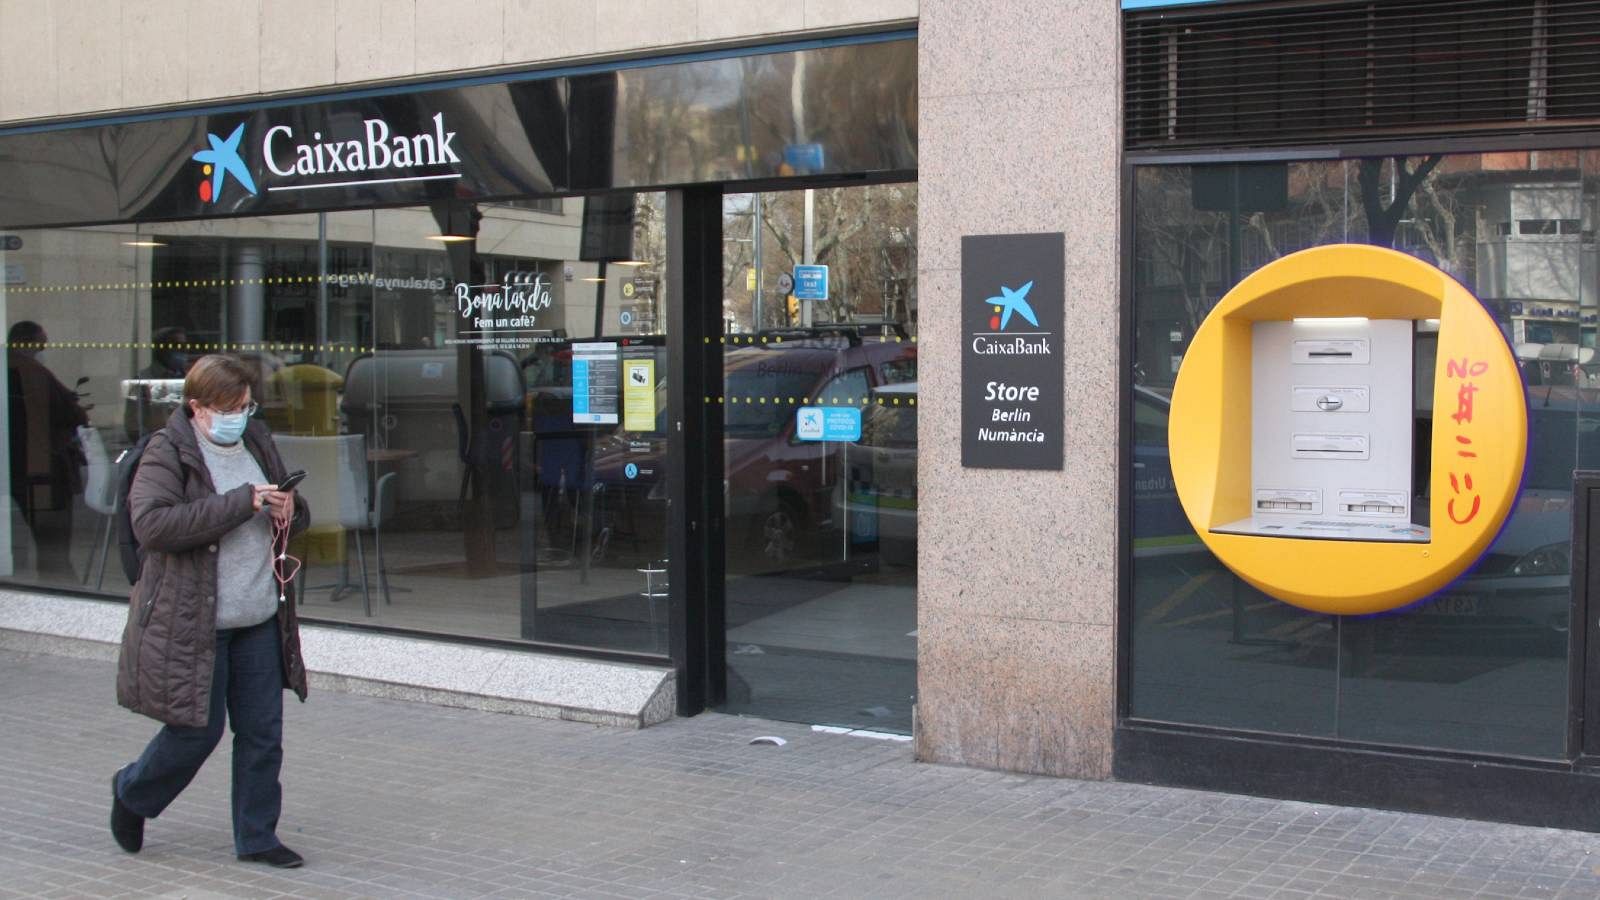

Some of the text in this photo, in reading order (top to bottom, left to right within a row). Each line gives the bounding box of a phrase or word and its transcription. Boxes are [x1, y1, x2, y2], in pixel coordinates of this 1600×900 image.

[263, 111, 460, 177] CaixaBank
[455, 276, 552, 318] Bona tarda
[474, 315, 535, 328] Fem un cafè?
[972, 336, 1051, 354] CaixaBank
[984, 381, 1040, 401] Store
[991, 407, 1031, 422] Berlin
